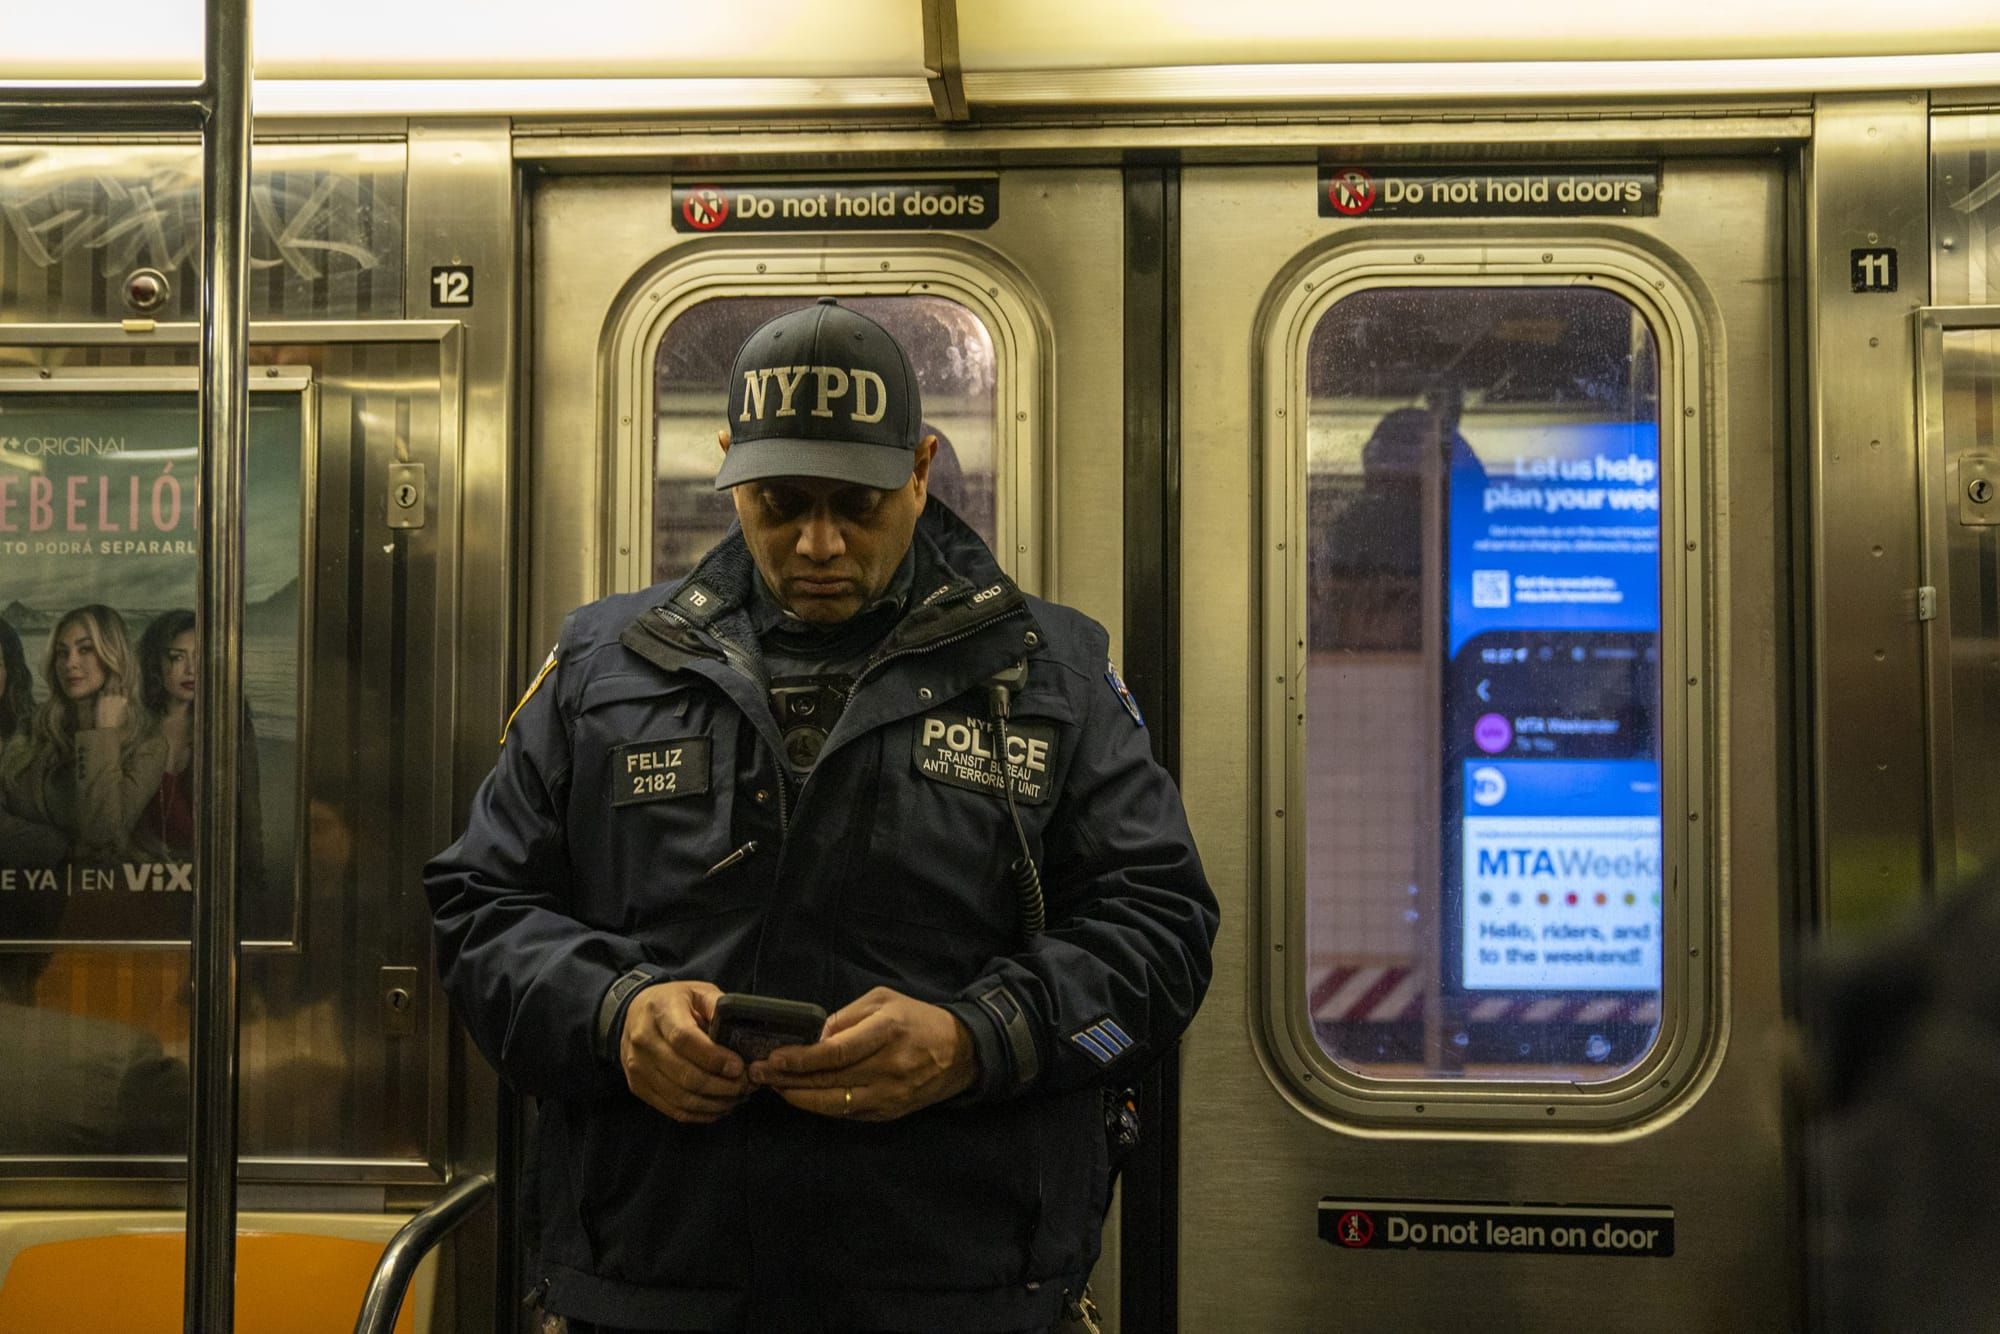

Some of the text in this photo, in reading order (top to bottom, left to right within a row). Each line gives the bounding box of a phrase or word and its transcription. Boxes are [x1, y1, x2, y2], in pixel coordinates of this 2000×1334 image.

[736, 190, 985, 218] Do not hold doors
[1384, 176, 1642, 204] Do not hold doors
[1858, 253, 1889, 287] 11
[433, 271, 469, 303] 12
[739, 365, 887, 424] NYPD
[1595, 454, 1655, 485] help
[0, 460, 199, 533] EBELIÓ
[1482, 484, 1543, 513] plan
[1544, 490, 1605, 513] your
[35, 538, 93, 554] PODRÁ
[627, 748, 682, 773] FELIZ
[937, 748, 985, 770] TRANSIT
[633, 772, 676, 794] 2182
[923, 758, 949, 775] ANTI
[1018, 780, 1041, 798] UNIT
[23, 869, 57, 891] YA
[82, 869, 114, 891] EN
[123, 863, 193, 892] ViX
[1479, 921, 1651, 942] Hello, riders, and
[1479, 947, 1500, 964] to
[1505, 947, 1538, 964] the
[1387, 1216, 1658, 1249] Do not lean on door
